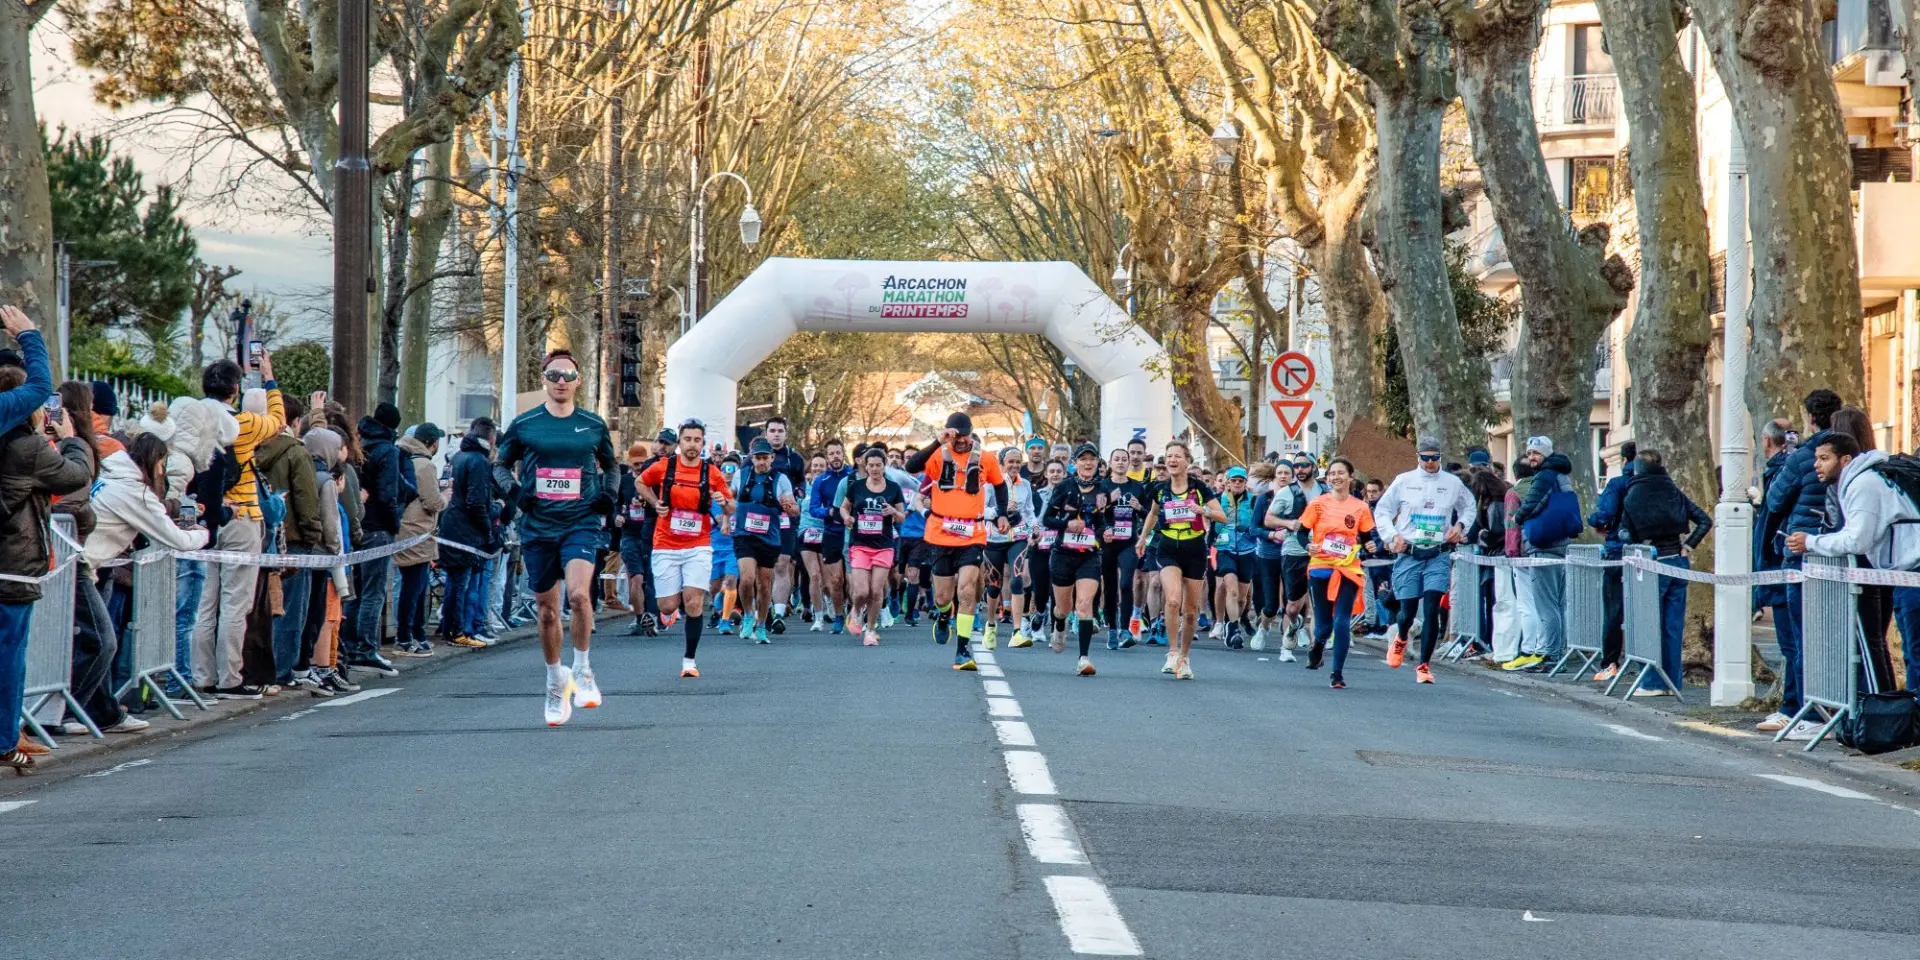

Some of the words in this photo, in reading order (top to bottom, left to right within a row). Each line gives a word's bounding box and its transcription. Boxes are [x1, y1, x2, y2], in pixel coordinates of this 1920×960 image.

[881, 275, 967, 290] ARCACHON
[883, 291, 966, 303] MARATHON
[869, 305, 881, 313] DU
[882, 305, 967, 317] PRINTEMPS
[546, 479, 570, 489] 2708
[950, 524, 967, 532] 2302
